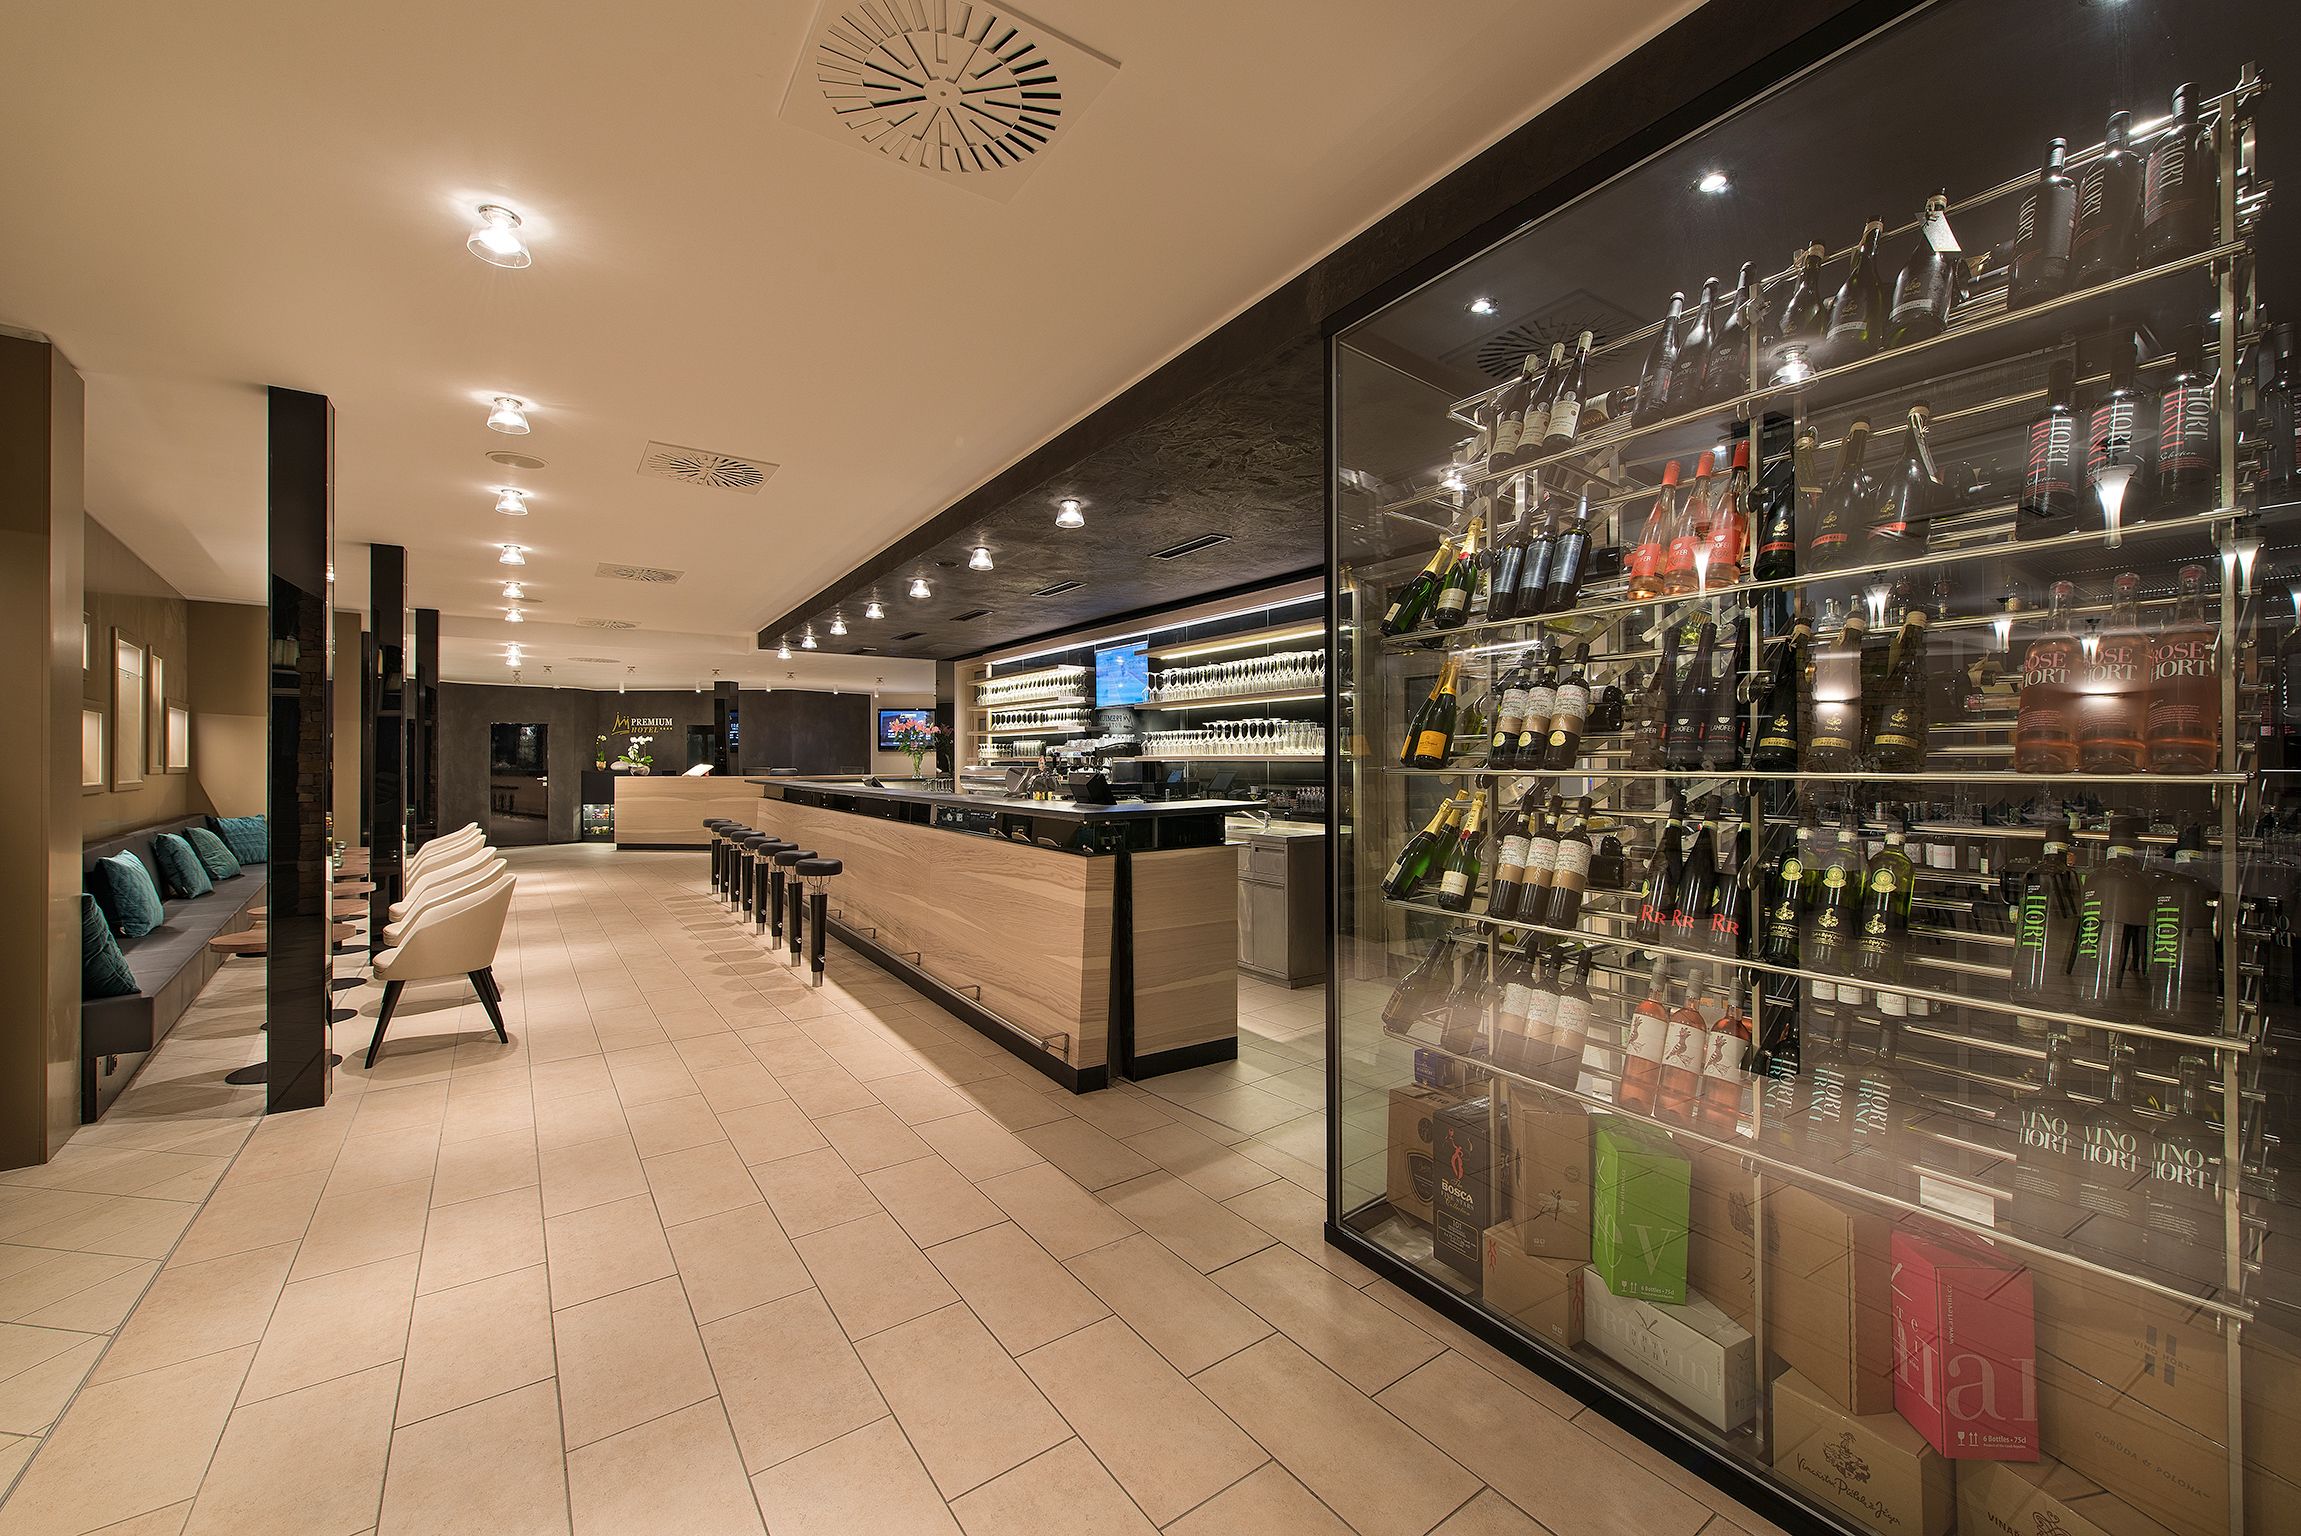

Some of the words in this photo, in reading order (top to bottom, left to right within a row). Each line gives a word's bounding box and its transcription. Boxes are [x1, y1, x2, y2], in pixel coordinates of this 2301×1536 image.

[2108, 402, 2135, 454] HORT
[2185, 387, 2211, 441] HORT
[2048, 416, 2073, 466] HORT
[2150, 658, 2211, 683] HORT
[631, 717, 673, 727] PREMIUM
[2022, 895, 2048, 952] HORT
[2080, 900, 2102, 959] HORT
[2154, 907, 2180, 969] HORT
[1777, 1059, 1798, 1109] HORT
[1823, 1071, 1845, 1122] HORT
[1868, 1081, 1891, 1135] HORT
[2021, 1110, 2069, 1137] VINO
[2018, 1127, 2073, 1155] HORT
[2084, 1125, 2138, 1153] VINO
[2082, 1143, 2141, 1173] HORT
[2152, 1142, 2205, 1168] VINO
[2151, 1161, 2211, 1190] HORT
[1441, 1181, 1475, 1204] BOSCA
[2133, 1339, 2158, 1356] VINO
[2163, 1354, 2192, 1372] HORT
[1988, 1434, 2010, 1443] Bottles
